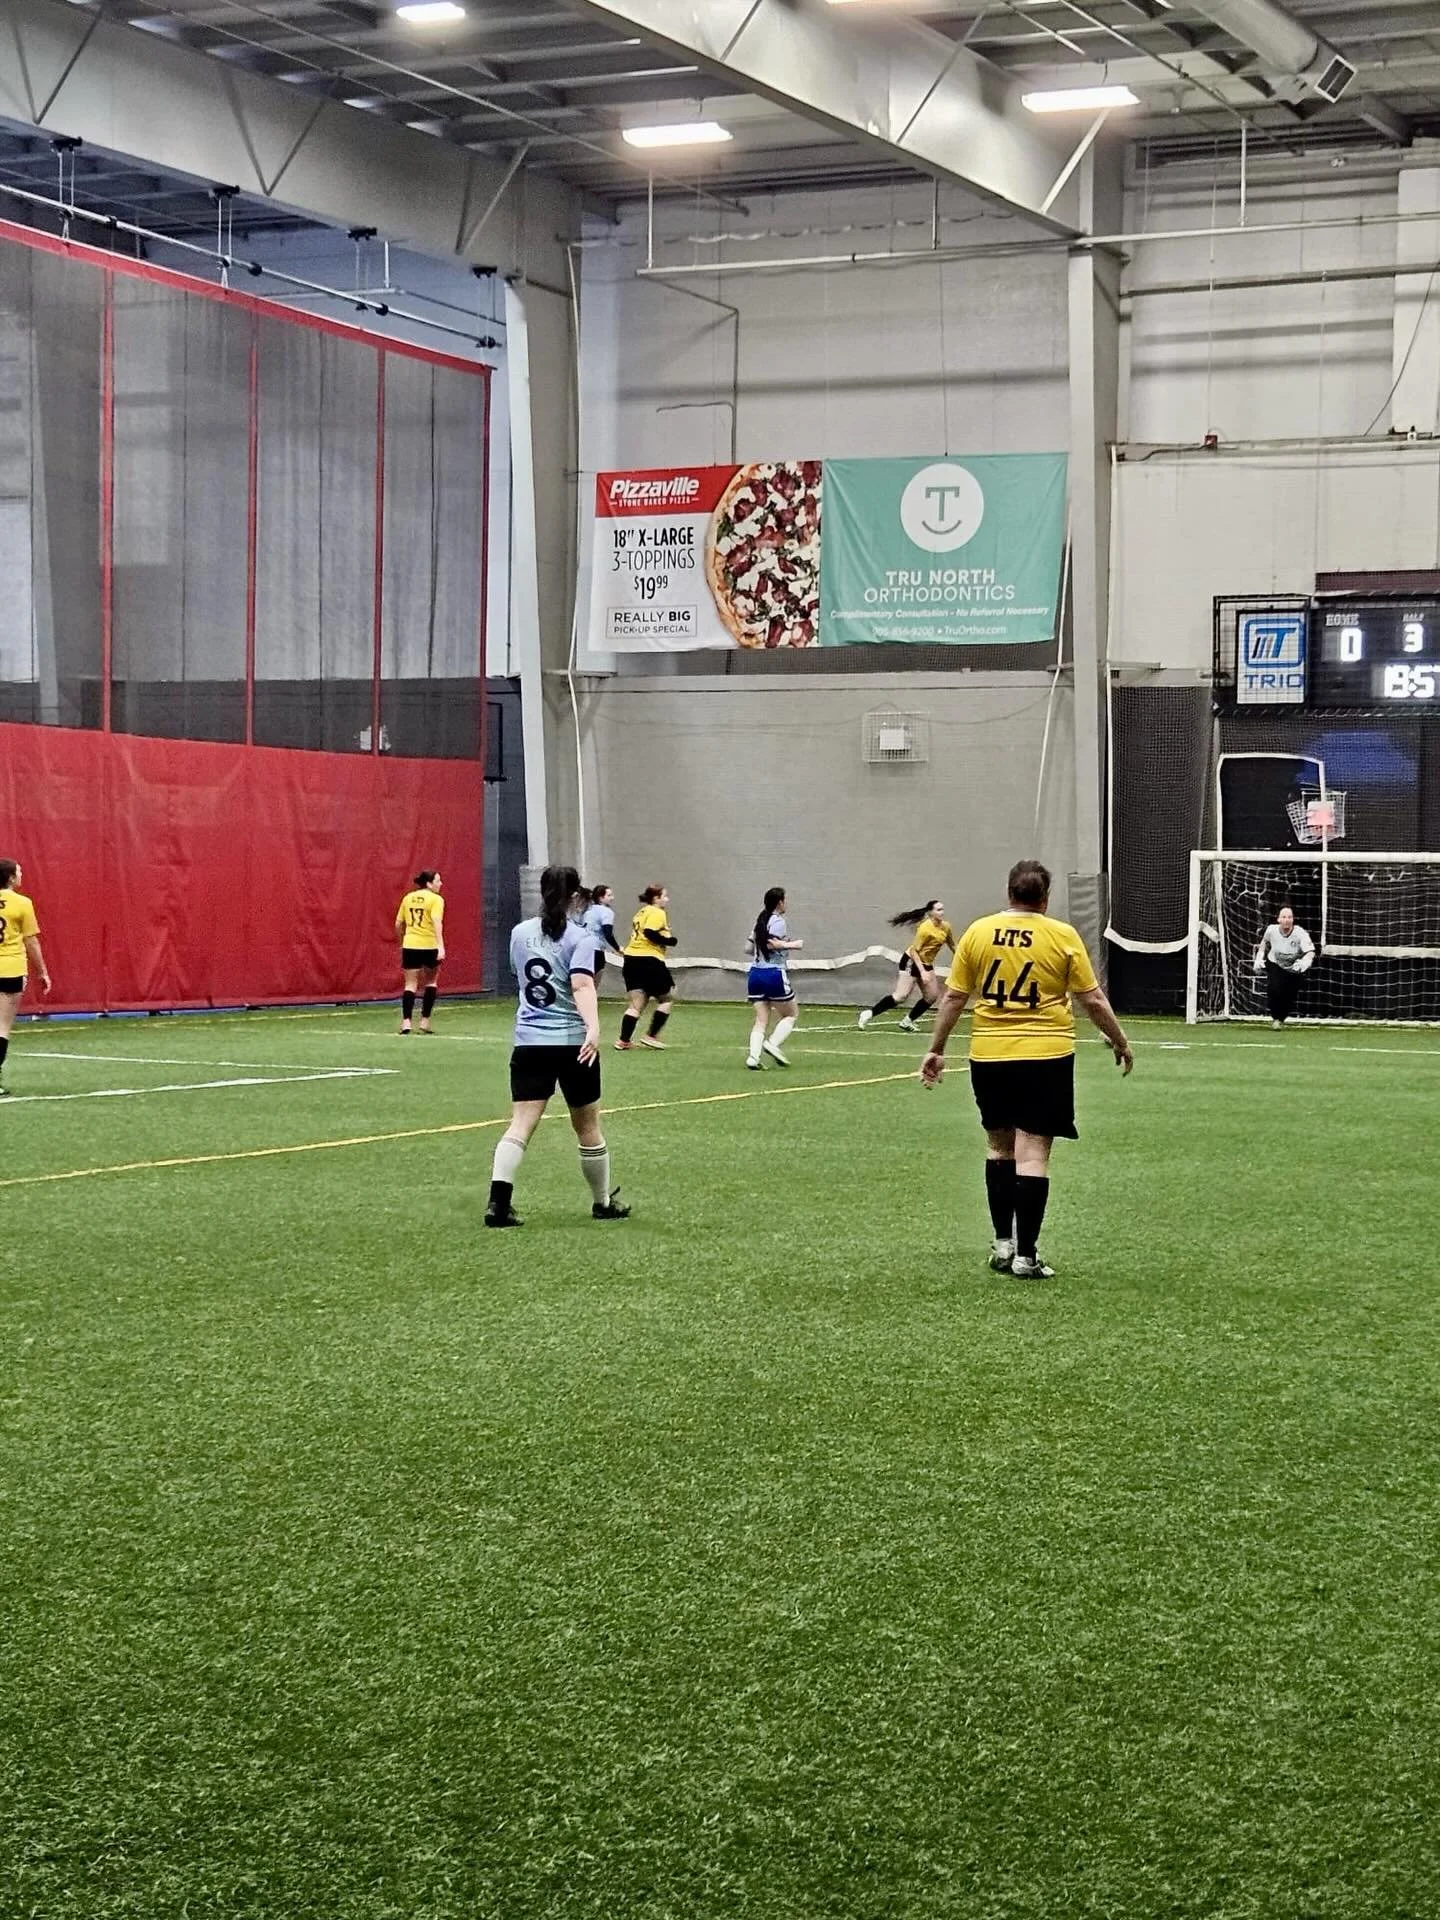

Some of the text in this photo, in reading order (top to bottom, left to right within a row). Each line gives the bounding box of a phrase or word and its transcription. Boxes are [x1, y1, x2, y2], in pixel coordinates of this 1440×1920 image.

[610, 477, 700, 499] Pizzaville
[639, 527, 695, 547] X-LARGE
[612, 548, 695, 572] 3-TOPPINGS
[886, 569, 996, 586] TRU NORTH
[864, 585, 1016, 603] ORTHODONTICS
[614, 611, 691, 624] REALLY BIG
[1325, 613, 1360, 627] HOME
[653, 625, 690, 634] SPECIAL
[1341, 622, 1424, 662] 0 3
[1244, 673, 1305, 689] TRIO
[409, 907, 425, 928] 17
[992, 928, 1034, 948] LTS
[525, 957, 557, 1009] 8
[982, 959, 1042, 1010] 44
